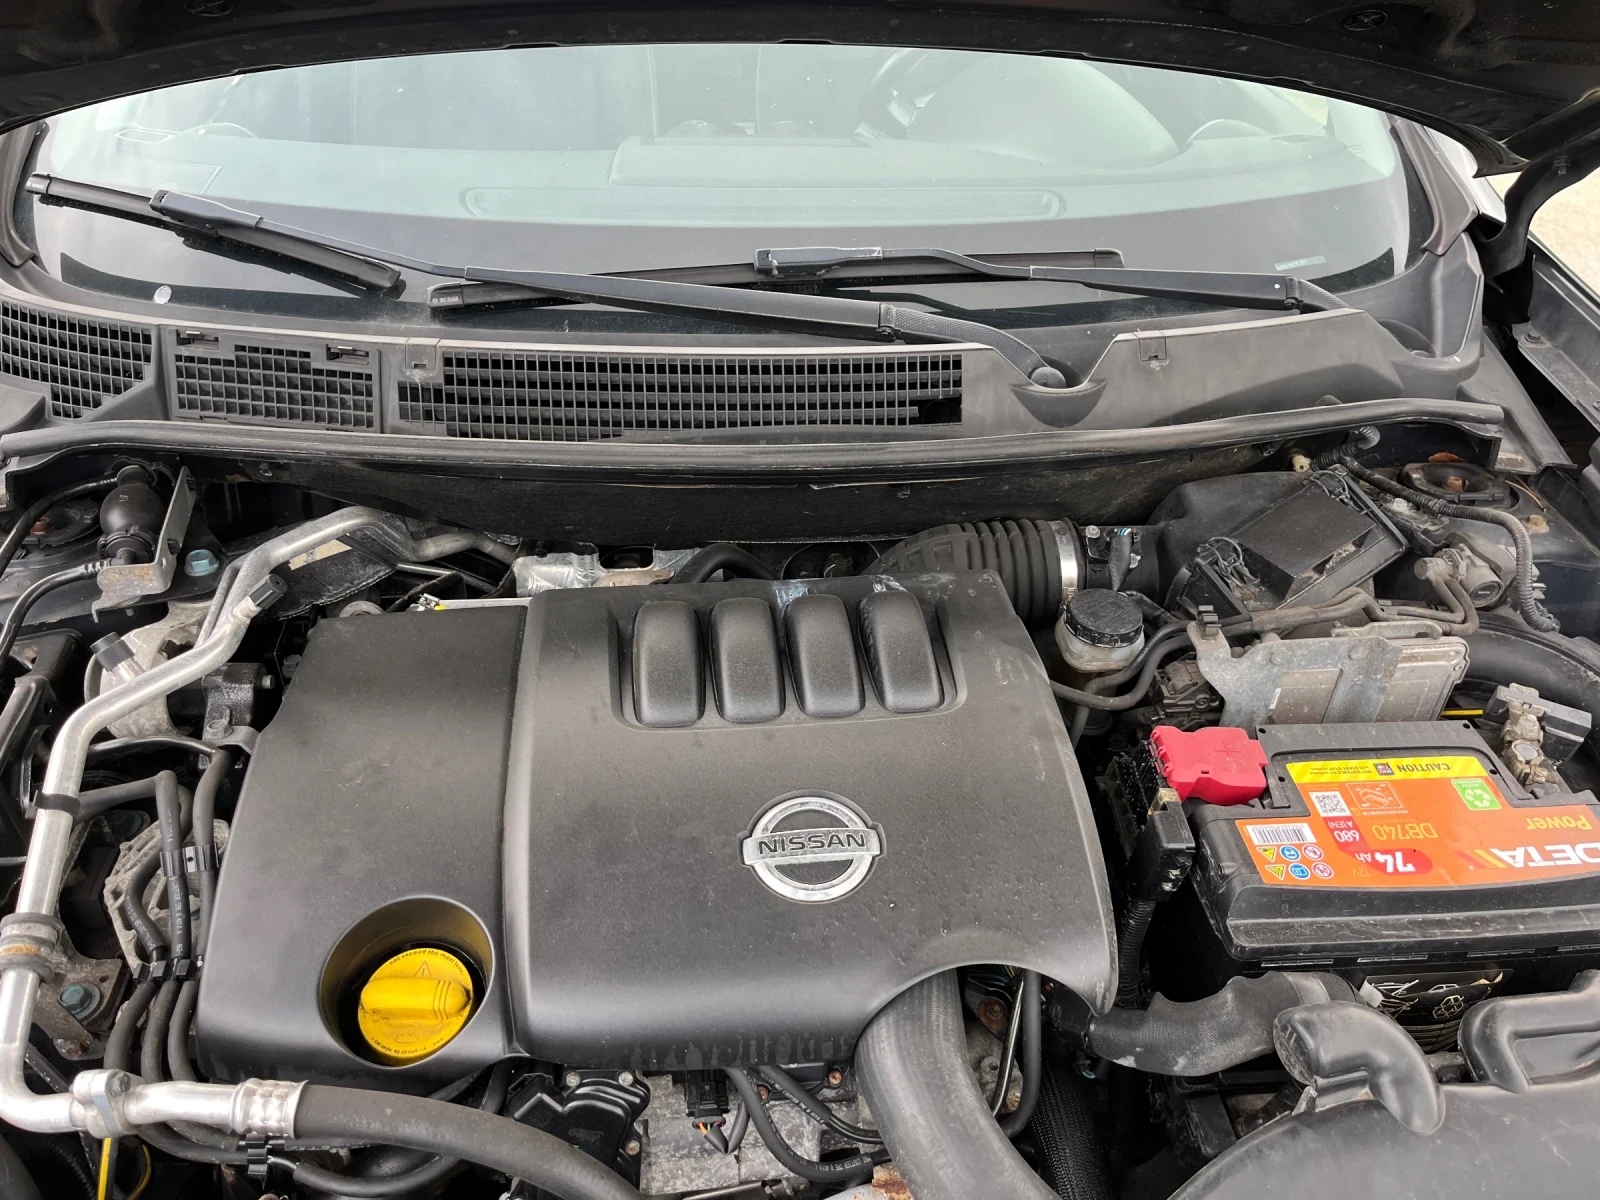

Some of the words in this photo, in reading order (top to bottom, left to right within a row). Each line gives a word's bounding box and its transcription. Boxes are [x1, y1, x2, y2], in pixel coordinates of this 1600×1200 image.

[1396, 763, 1450, 773] CAUTION
[1526, 815, 1592, 831] Power
[1334, 830, 1360, 842] 680
[1371, 822, 1439, 841] DB740
[759, 833, 866, 855] NISSAN
[1355, 852, 1372, 863] Ah
[1374, 851, 1416, 873] 74
[1490, 842, 1600, 868] DETA
[1352, 868, 1372, 878] 12V
[389, 956, 401, 966] not
